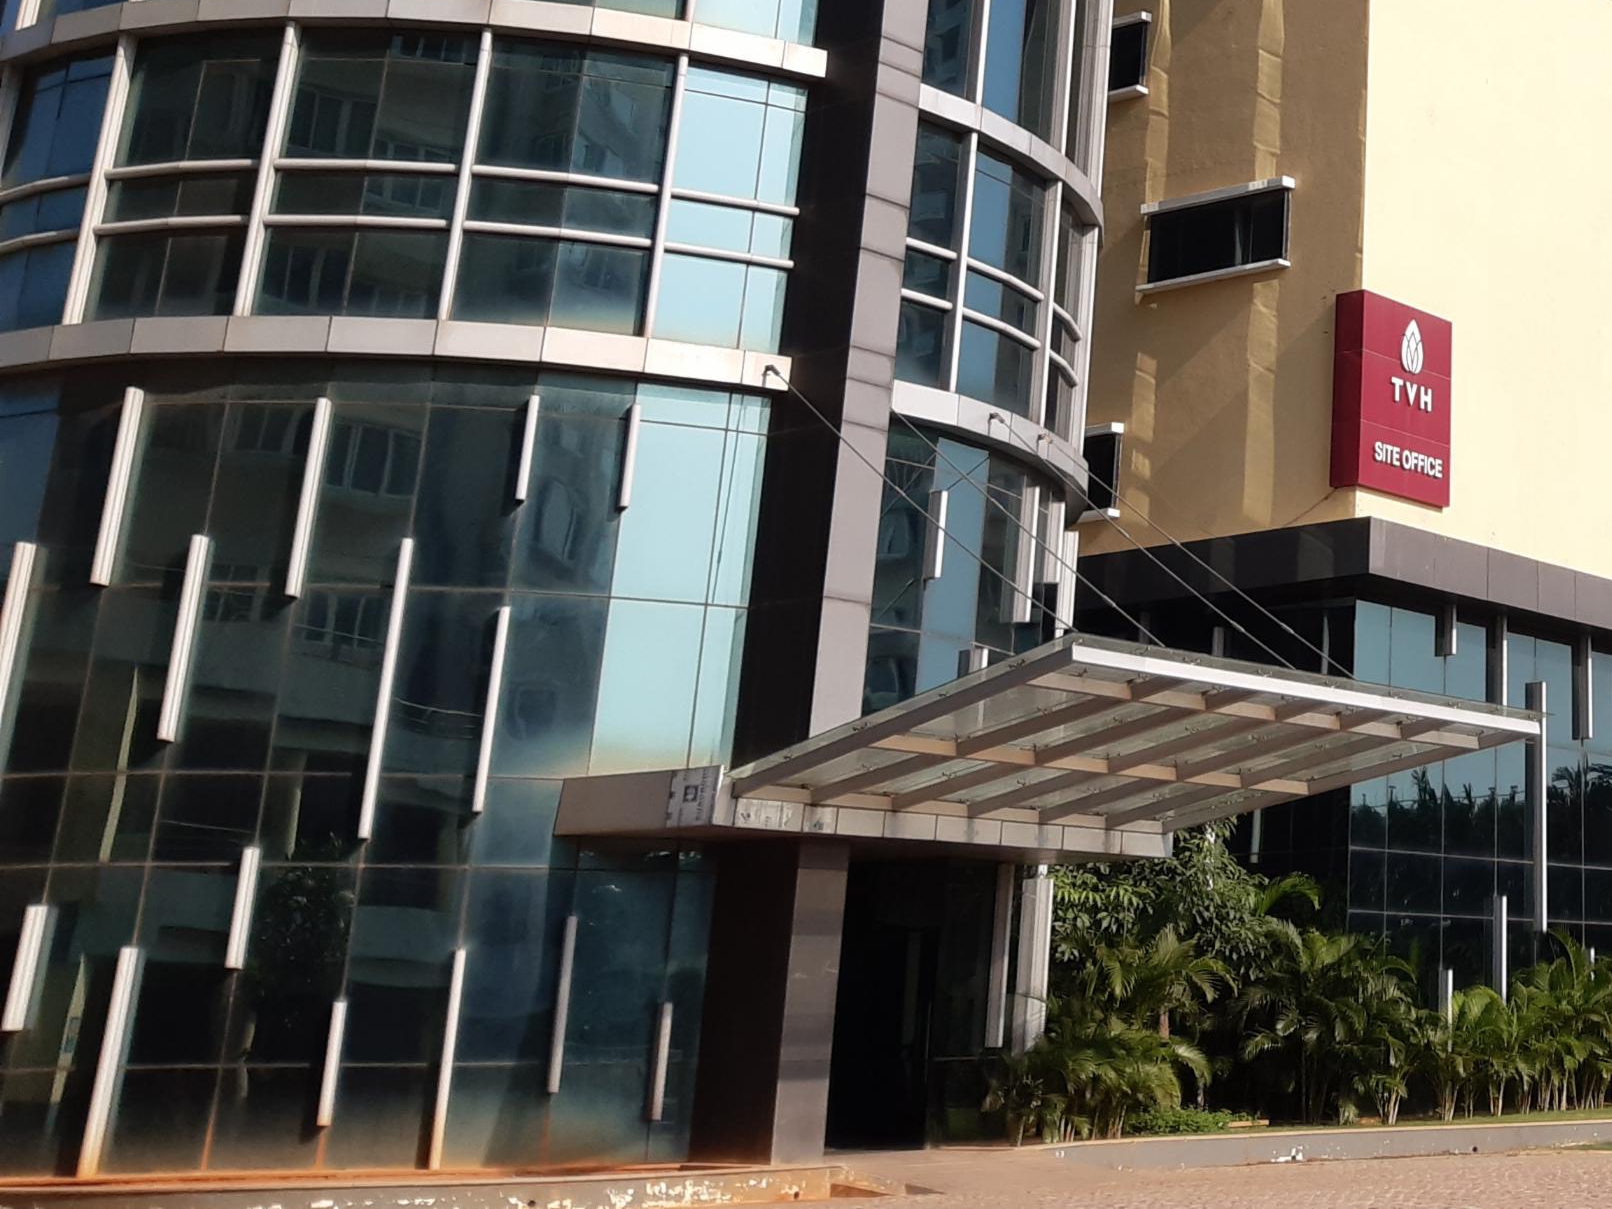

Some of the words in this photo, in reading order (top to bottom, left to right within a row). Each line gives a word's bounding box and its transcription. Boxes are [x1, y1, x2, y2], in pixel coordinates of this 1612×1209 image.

[1391, 376, 1433, 412] TVH
[1374, 441, 1400, 466] SITE
[1402, 450, 1443, 478] OFFICE
